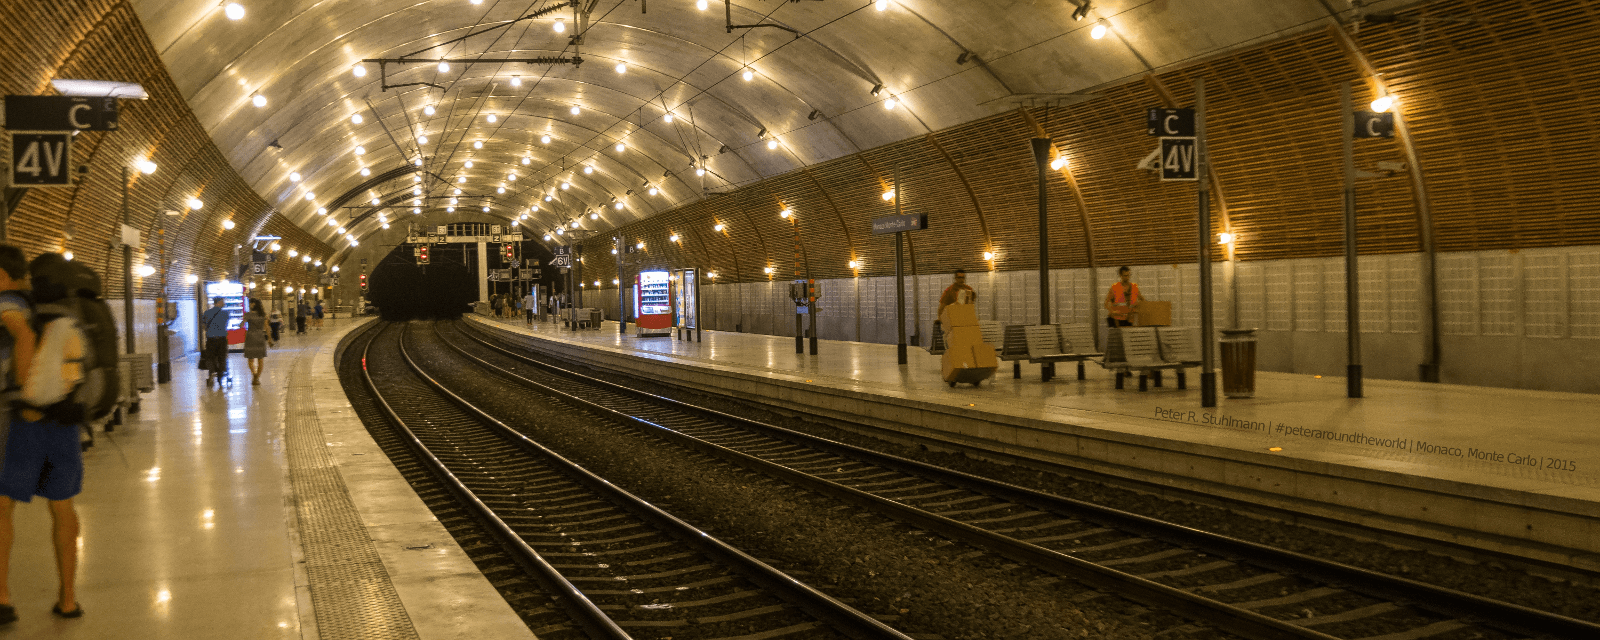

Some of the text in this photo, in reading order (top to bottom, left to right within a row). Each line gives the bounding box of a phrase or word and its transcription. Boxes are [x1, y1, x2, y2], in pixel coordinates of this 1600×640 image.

[69, 103, 92, 129] C
[1164, 115, 1179, 135] C
[1366, 117, 1381, 136] C
[16, 141, 65, 177] 4V
[1164, 145, 1193, 173] 4V
[254, 263, 266, 273] 6V
[557, 256, 568, 265] 6V
